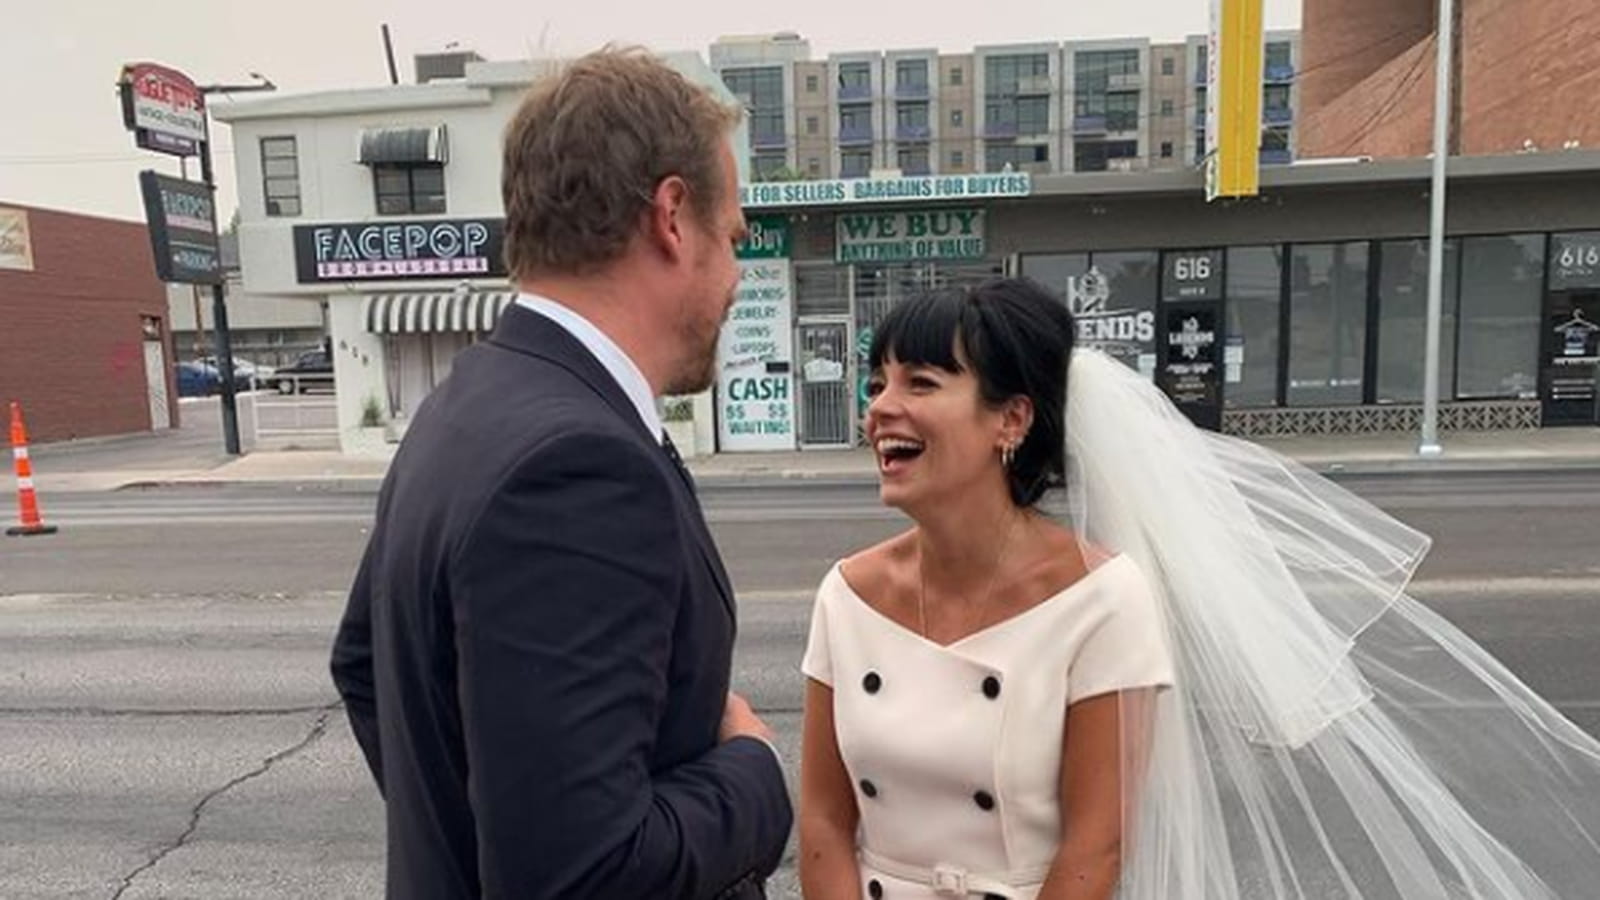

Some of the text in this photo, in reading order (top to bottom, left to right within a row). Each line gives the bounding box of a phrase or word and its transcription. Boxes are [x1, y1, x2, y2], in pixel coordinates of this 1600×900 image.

[753, 185, 781, 203] FOR
[784, 182, 846, 202] SELLERS
[854, 180, 933, 199] BARGAINS
[936, 178, 964, 196] FOR
[967, 176, 1028, 194] BUYERS
[841, 211, 978, 239] WE BUY
[314, 222, 488, 261] FACEPOP
[841, 238, 983, 261] ANYTHING OF VALUE
[1175, 256, 1211, 280] 616
[1560, 246, 1599, 267] 616
[1077, 311, 1155, 341] ENDS
[728, 377, 788, 401] CASH
